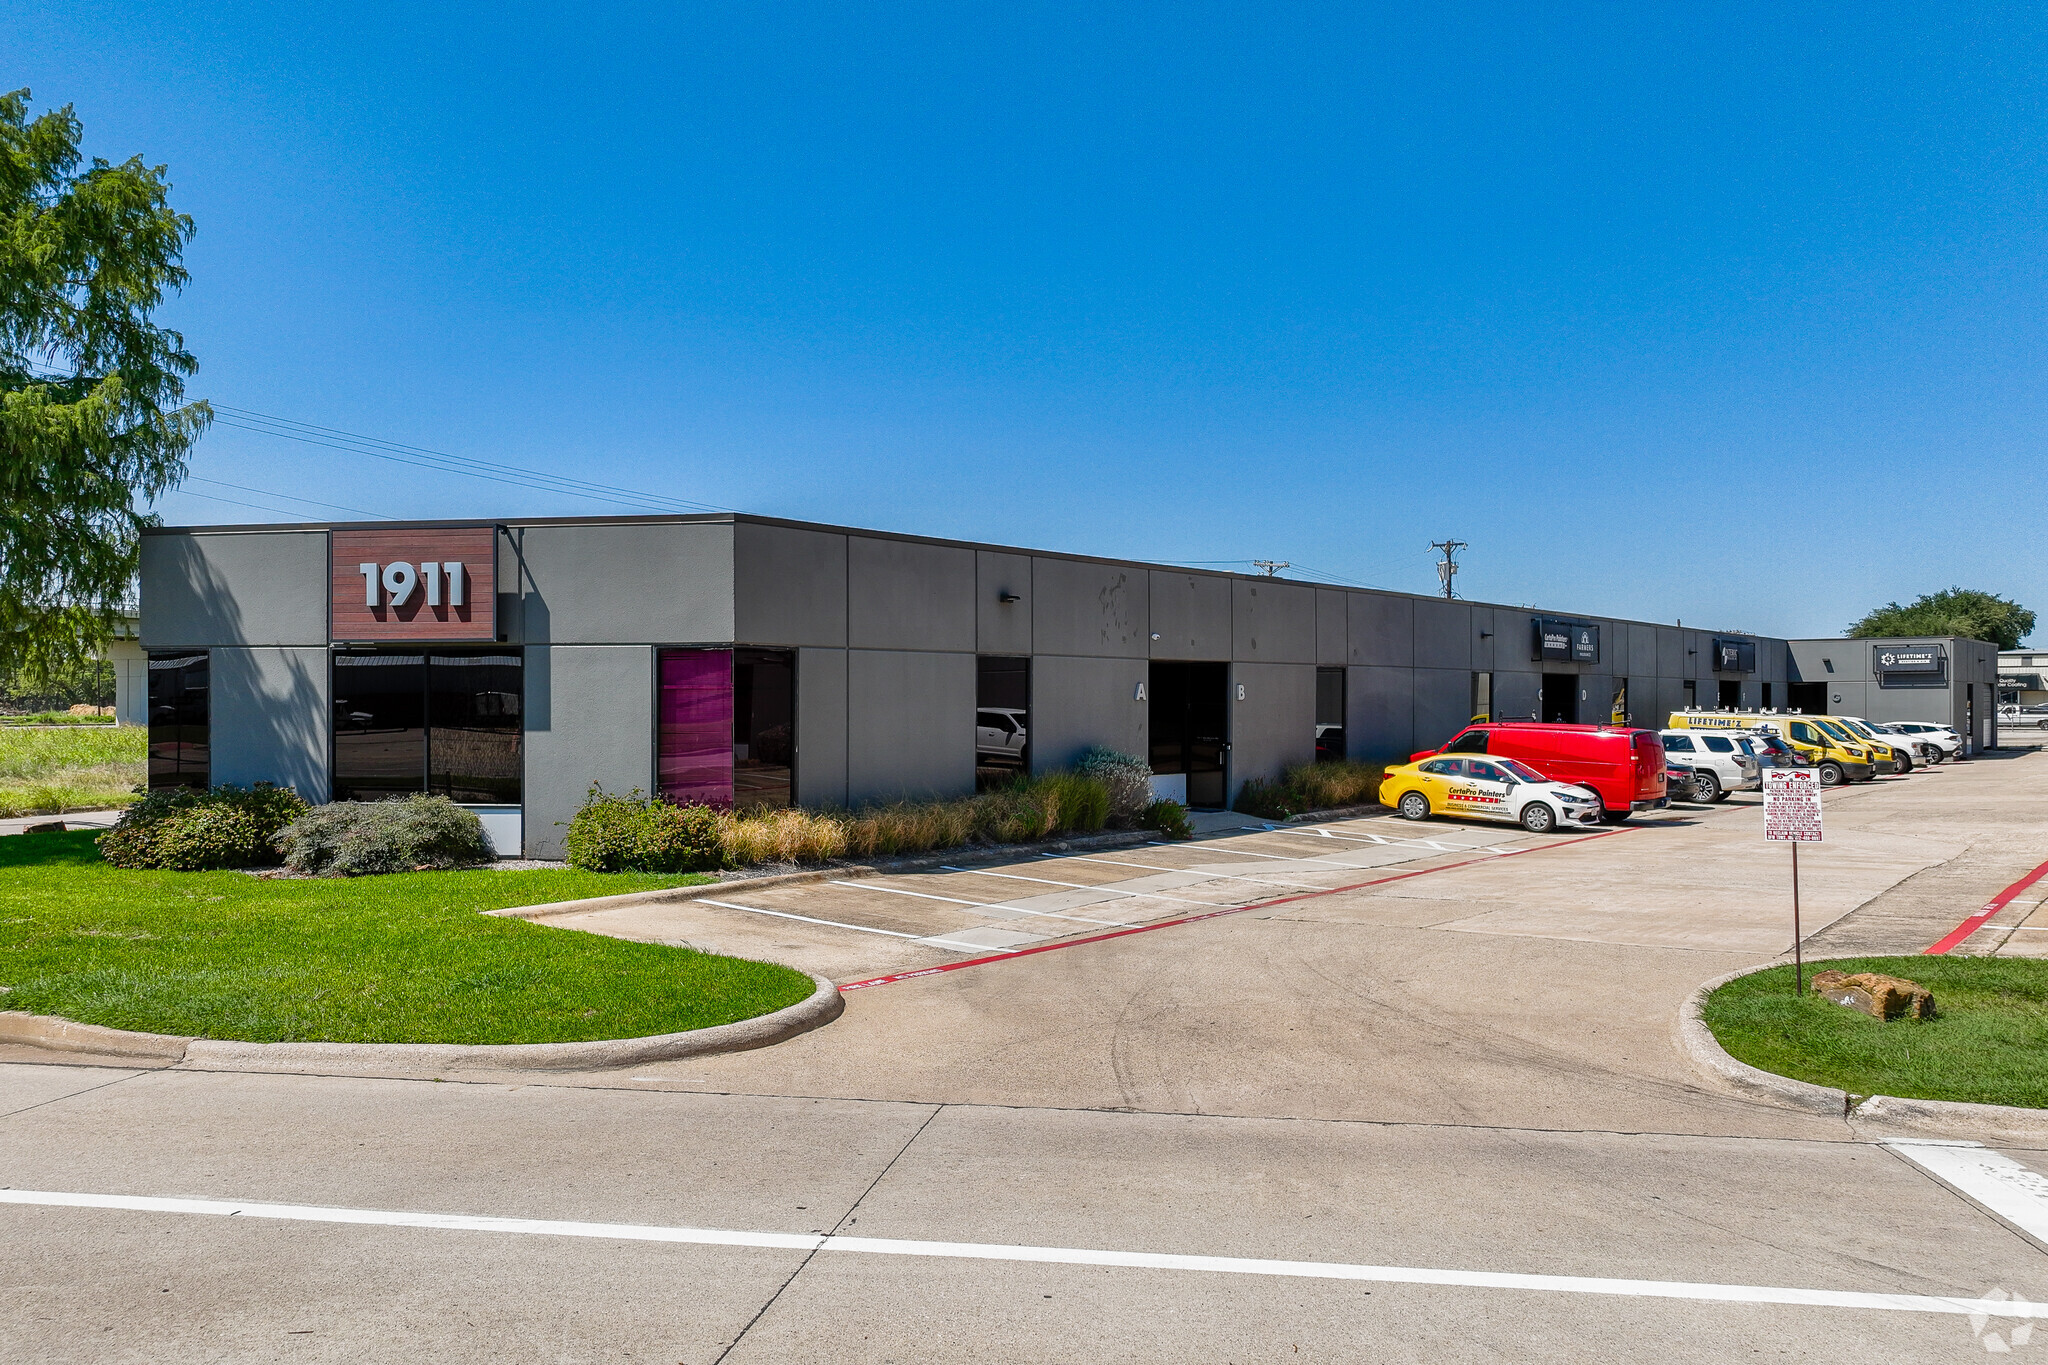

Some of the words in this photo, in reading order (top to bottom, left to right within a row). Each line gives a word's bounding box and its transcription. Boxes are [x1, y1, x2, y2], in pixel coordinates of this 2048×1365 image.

[360, 561, 464, 606] 1911
[1576, 643, 1594, 651] FARMERS
[1134, 682, 1147, 700] A
[1236, 683, 1246, 701] B
[1582, 689, 1587, 701] D
[1688, 717, 1742, 727] LIFETIME'Z
[1789, 782, 1819, 790] ENFORCED
[1449, 787, 1477, 796] CertaPro
[1478, 790, 1506, 798] Painters
